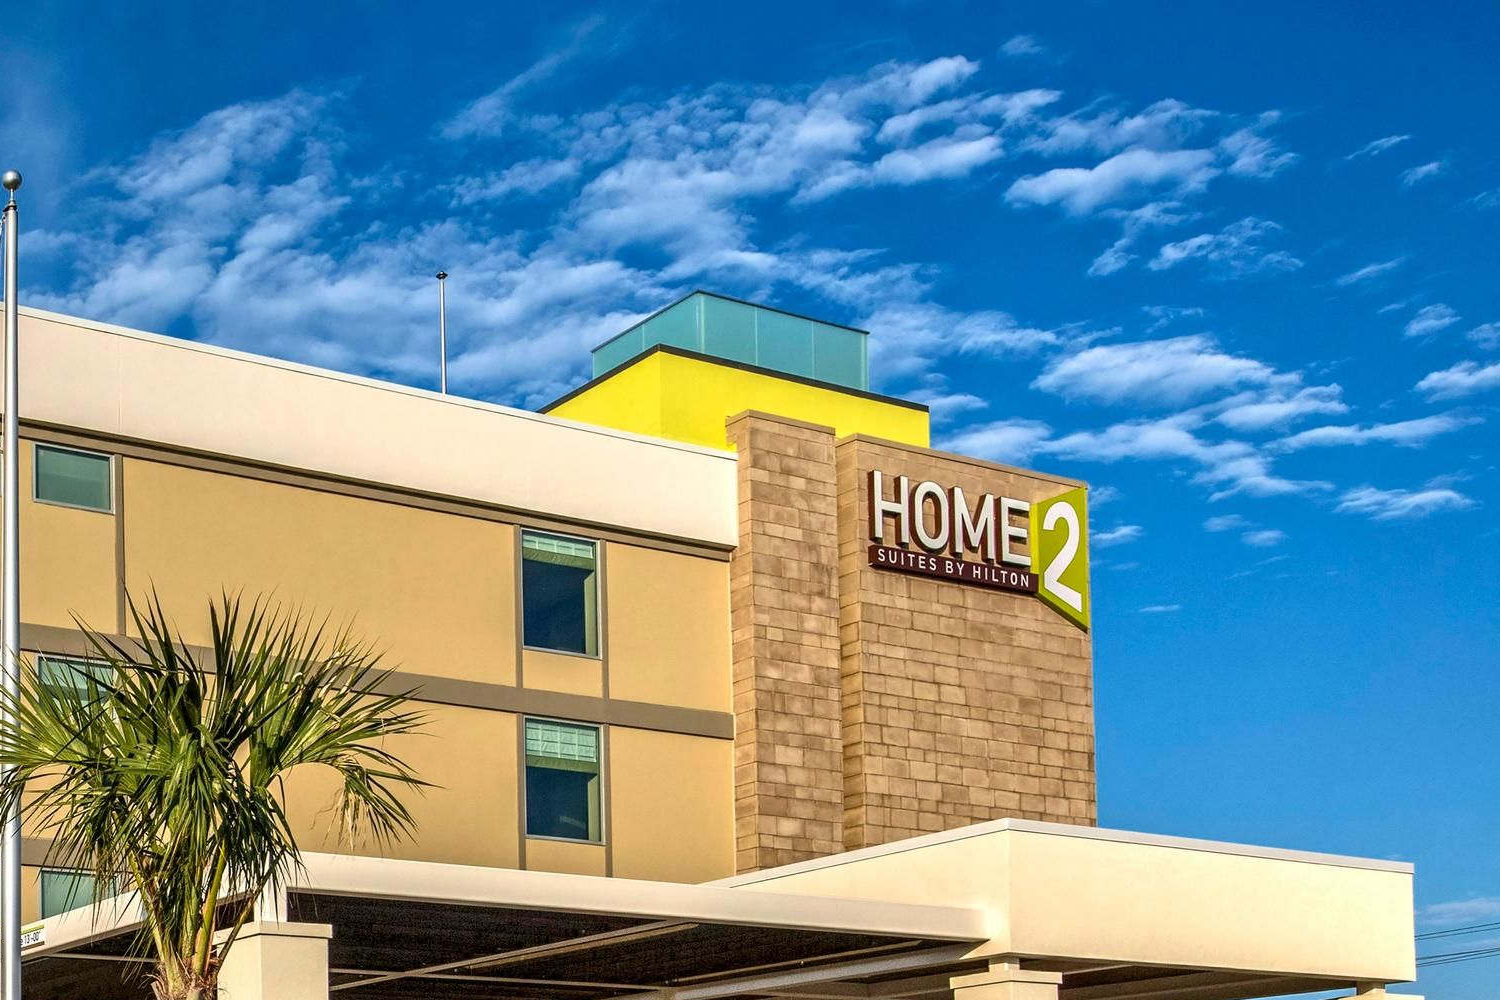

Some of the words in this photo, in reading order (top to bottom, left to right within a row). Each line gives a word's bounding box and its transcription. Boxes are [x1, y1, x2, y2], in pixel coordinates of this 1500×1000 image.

[871, 469, 1032, 567] HOME
[1043, 501, 1082, 613] 2
[877, 548, 937, 571] SUITES
[945, 560, 965, 576] BY
[972, 565, 1029, 588] HILTON
